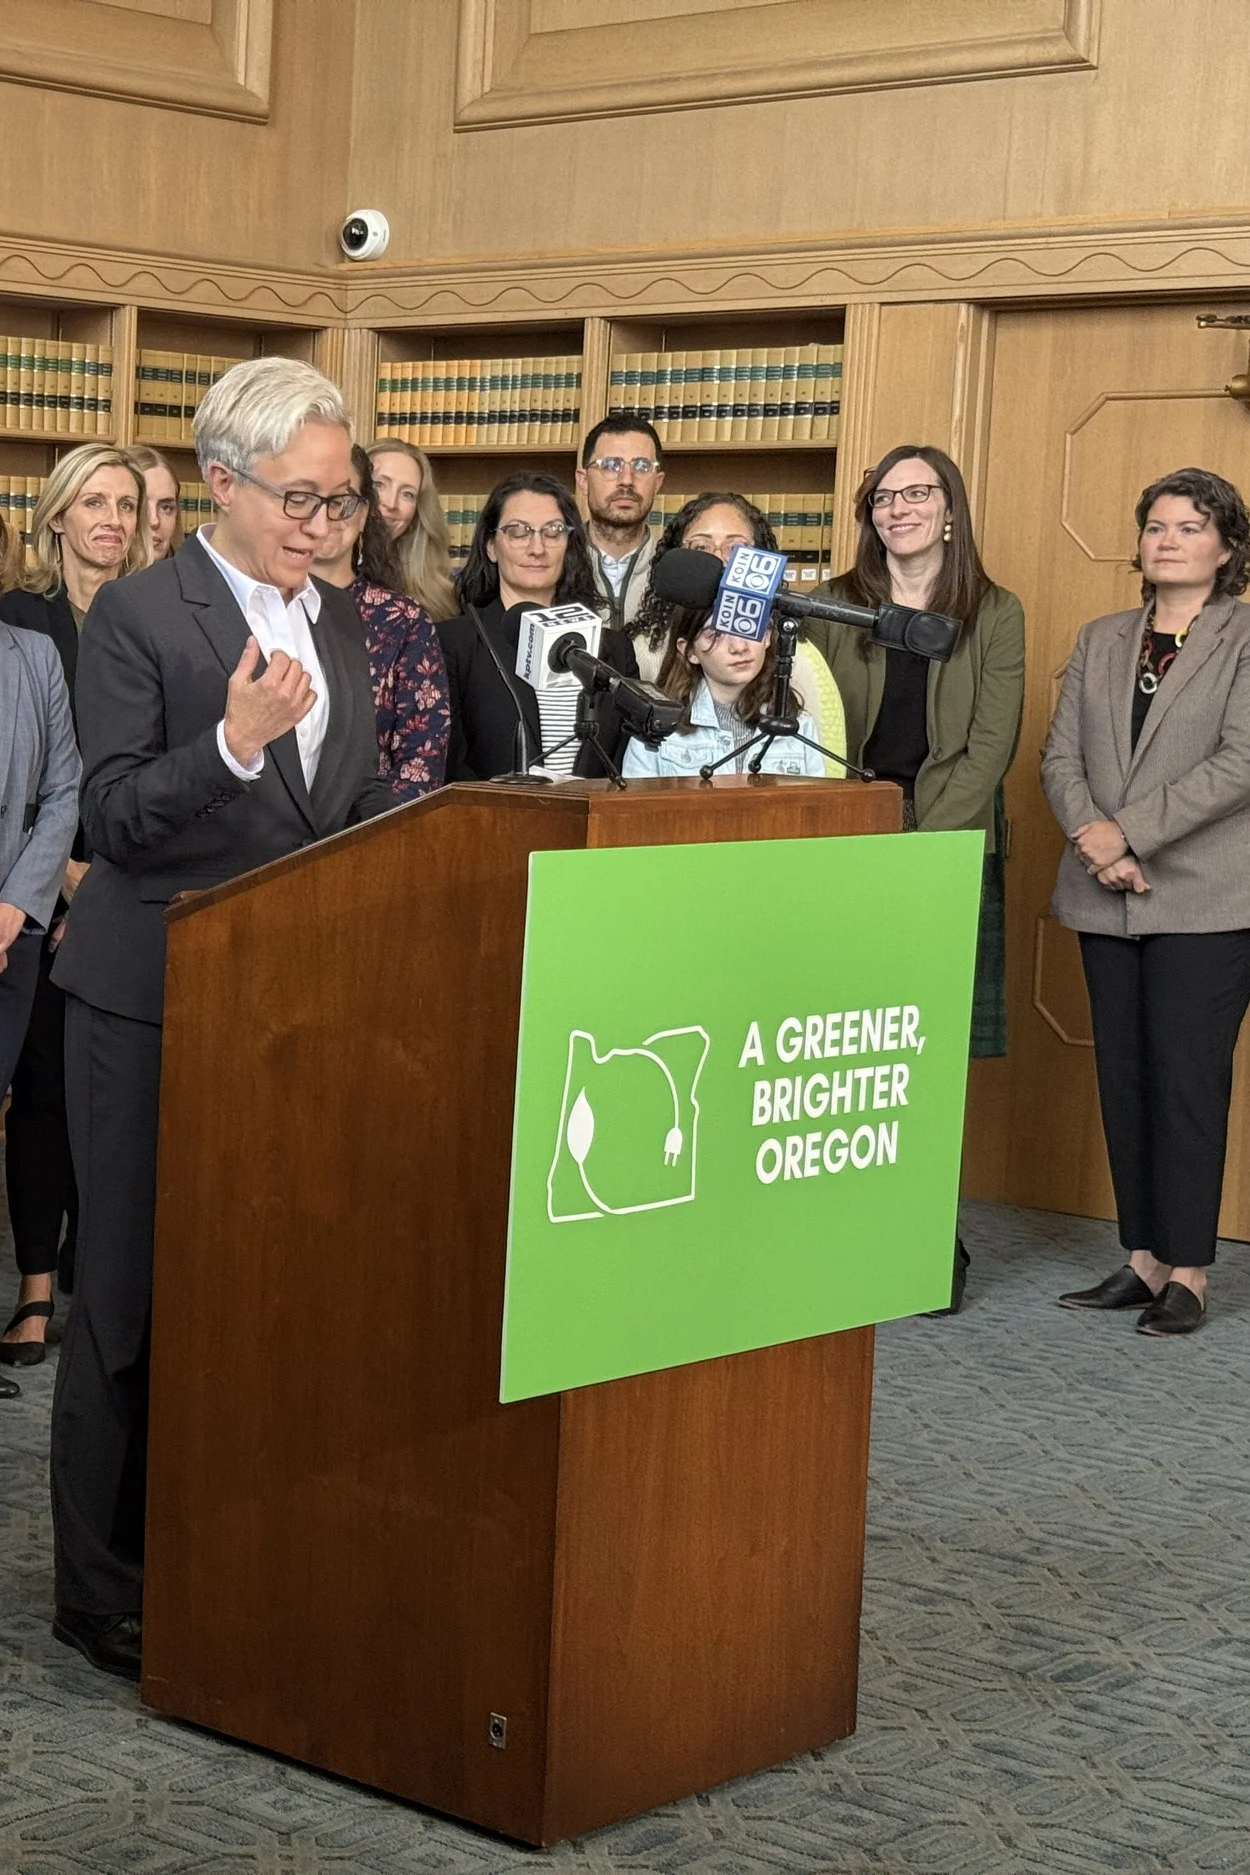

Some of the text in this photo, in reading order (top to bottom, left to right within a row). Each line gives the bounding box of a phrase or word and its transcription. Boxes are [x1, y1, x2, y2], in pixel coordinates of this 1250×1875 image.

[730, 551, 751, 584] KOIN
[528, 605, 591, 624] 12
[719, 594, 737, 628] KOIN
[523, 623, 535, 681] kptv.com
[738, 1004, 927, 1068] A GREENER,
[751, 1062, 910, 1126] BRIGHTER
[755, 1120, 899, 1185] OREGON
